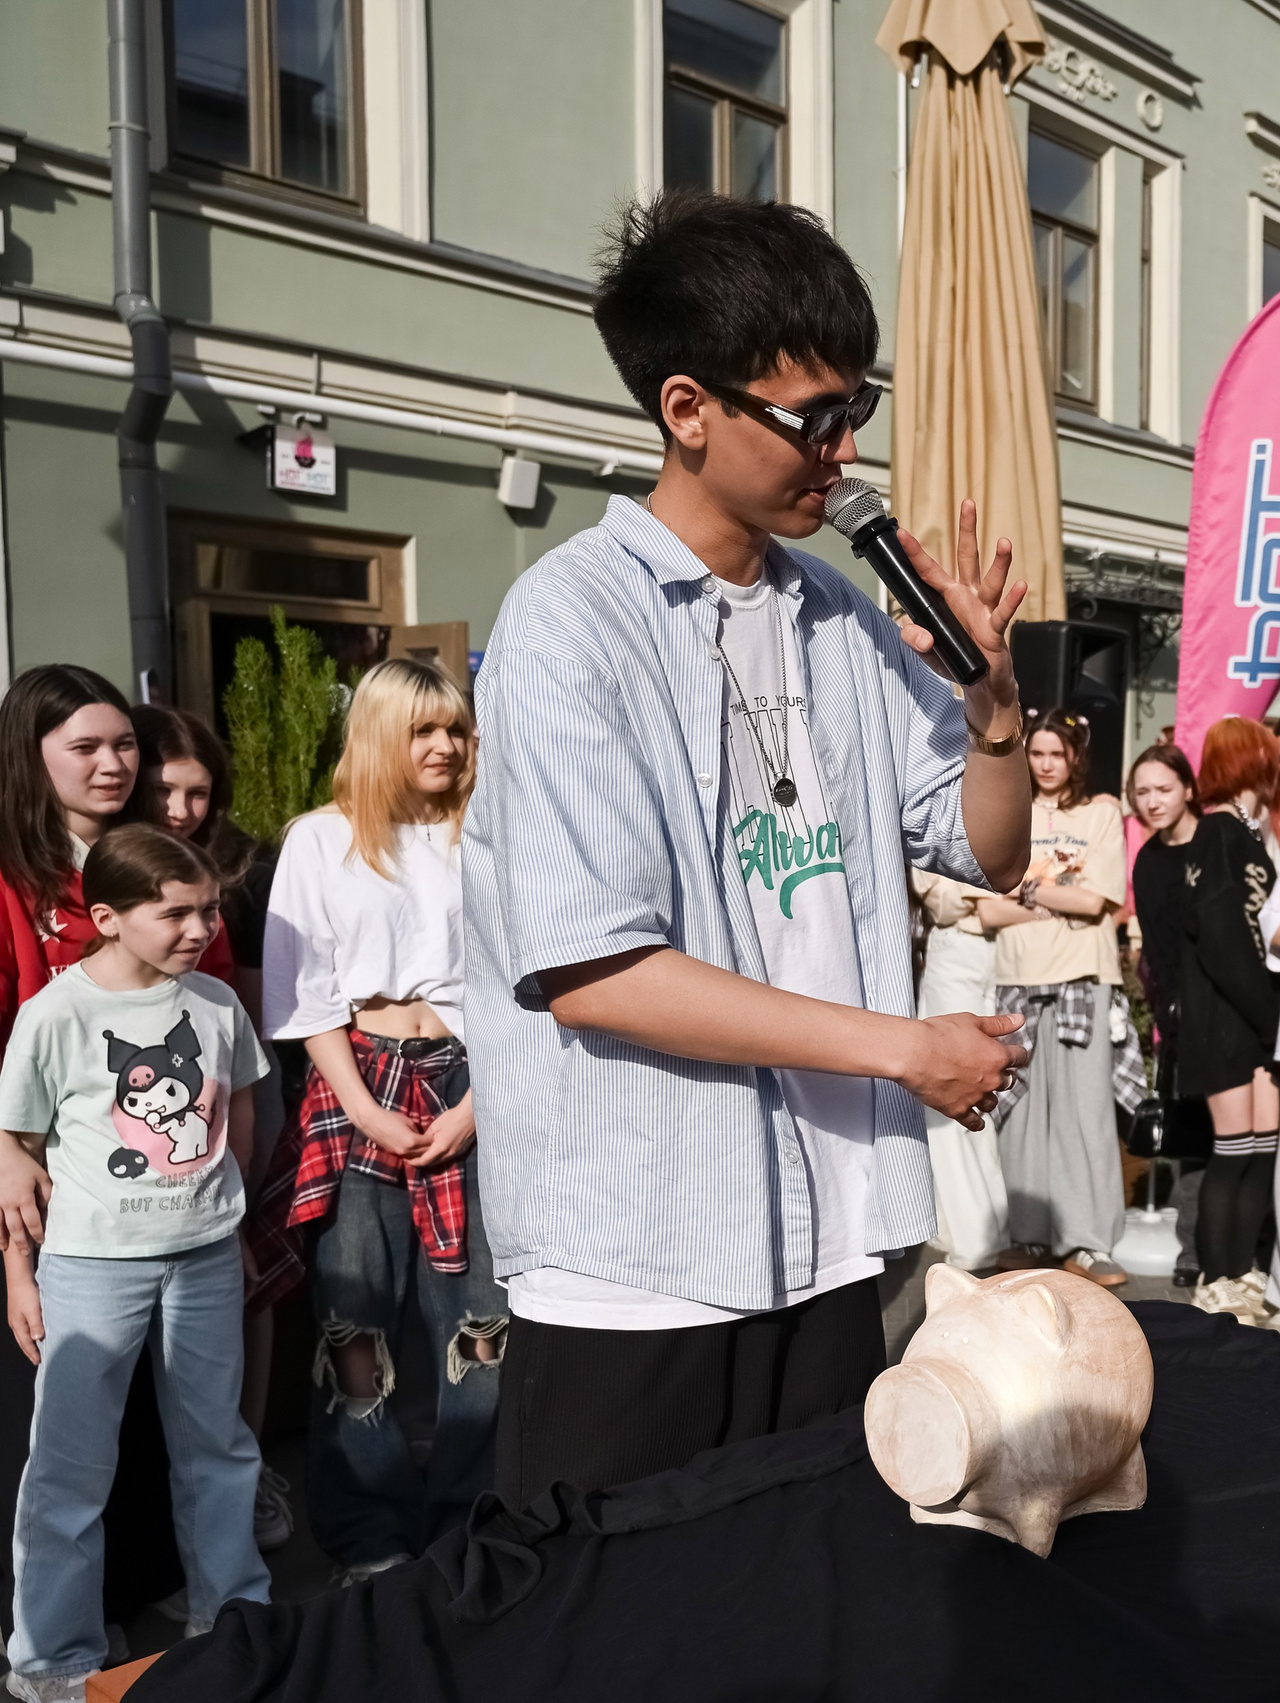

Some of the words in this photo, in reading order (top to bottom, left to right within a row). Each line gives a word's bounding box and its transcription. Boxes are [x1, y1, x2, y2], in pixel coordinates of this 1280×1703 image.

[754, 696, 767, 708] TO
[733, 809, 845, 919] Alwa
[120, 1197, 152, 1213] BUT
